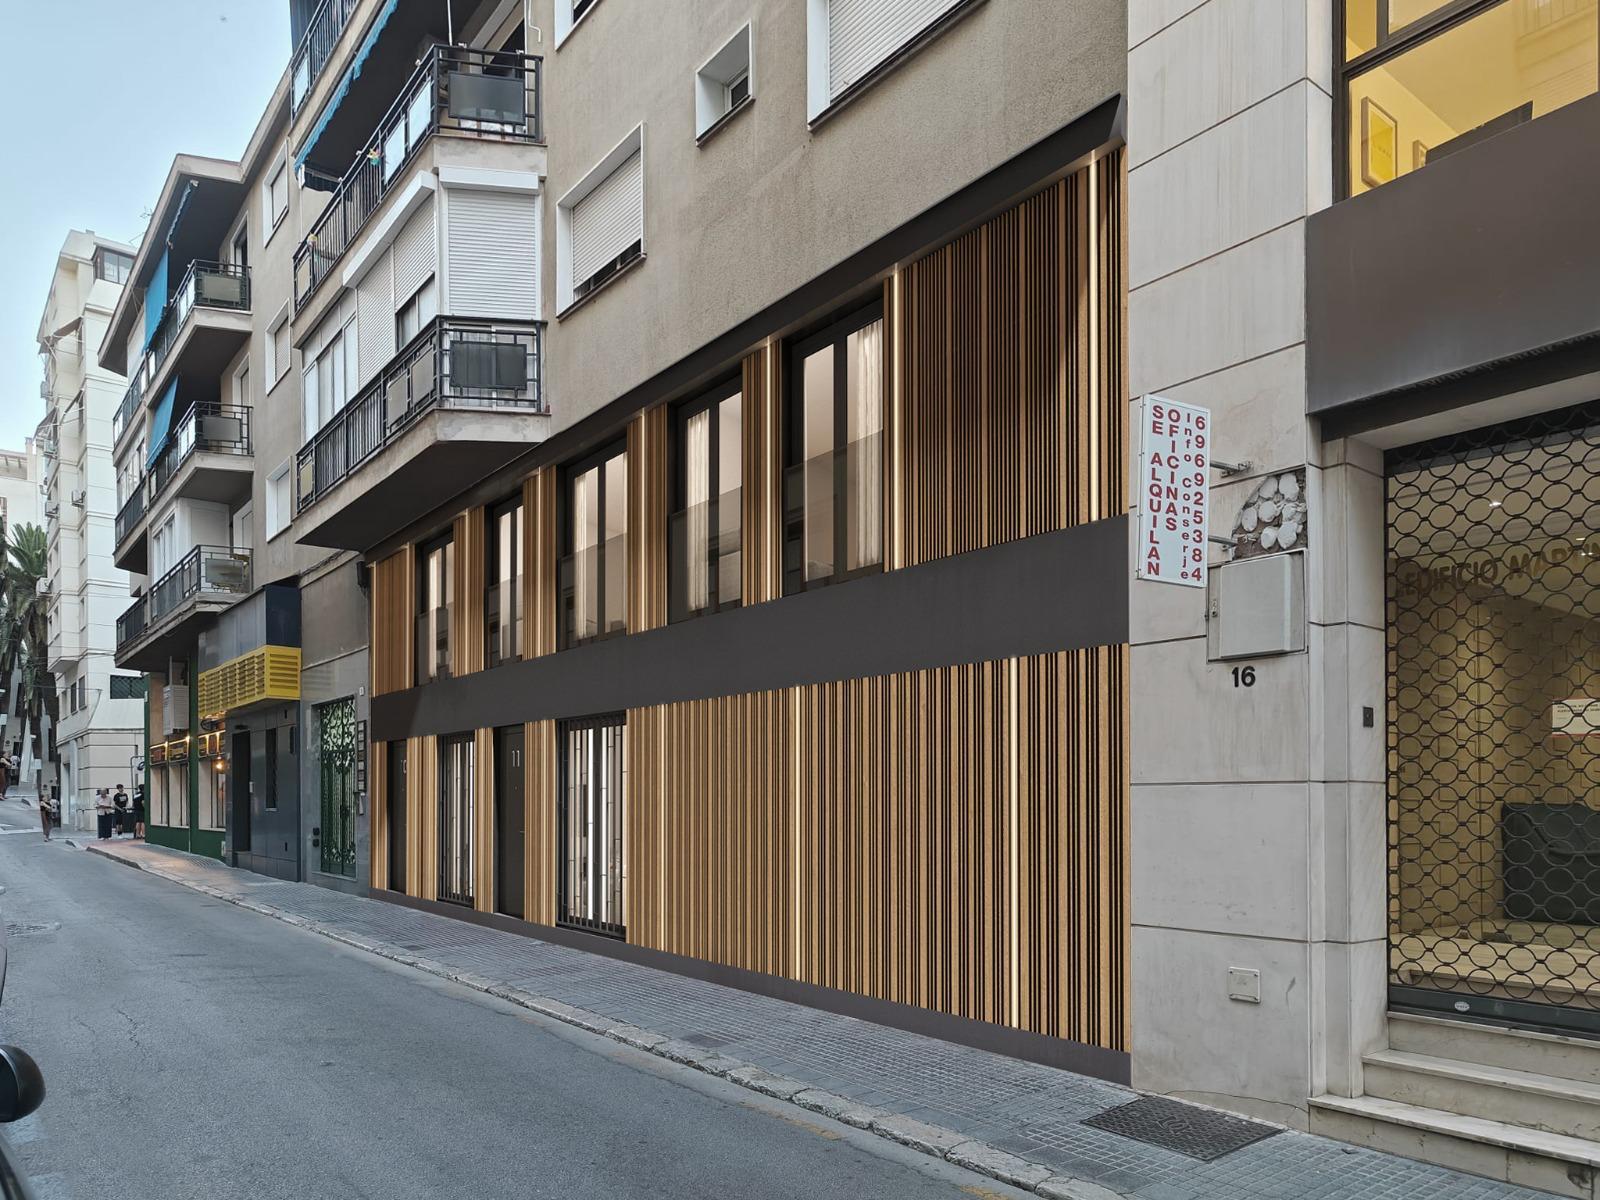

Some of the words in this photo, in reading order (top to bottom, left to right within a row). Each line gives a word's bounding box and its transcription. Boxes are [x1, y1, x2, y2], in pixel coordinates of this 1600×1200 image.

[1152, 405, 1164, 435] SE
[1165, 409, 1181, 531] OFICINAS
[1184, 413, 1192, 462] Info
[1147, 452, 1163, 576] ALQUILAN
[1181, 477, 1192, 580] Conserje
[1191, 416, 1206, 581] 696925384
[1231, 665, 1256, 688] 16
